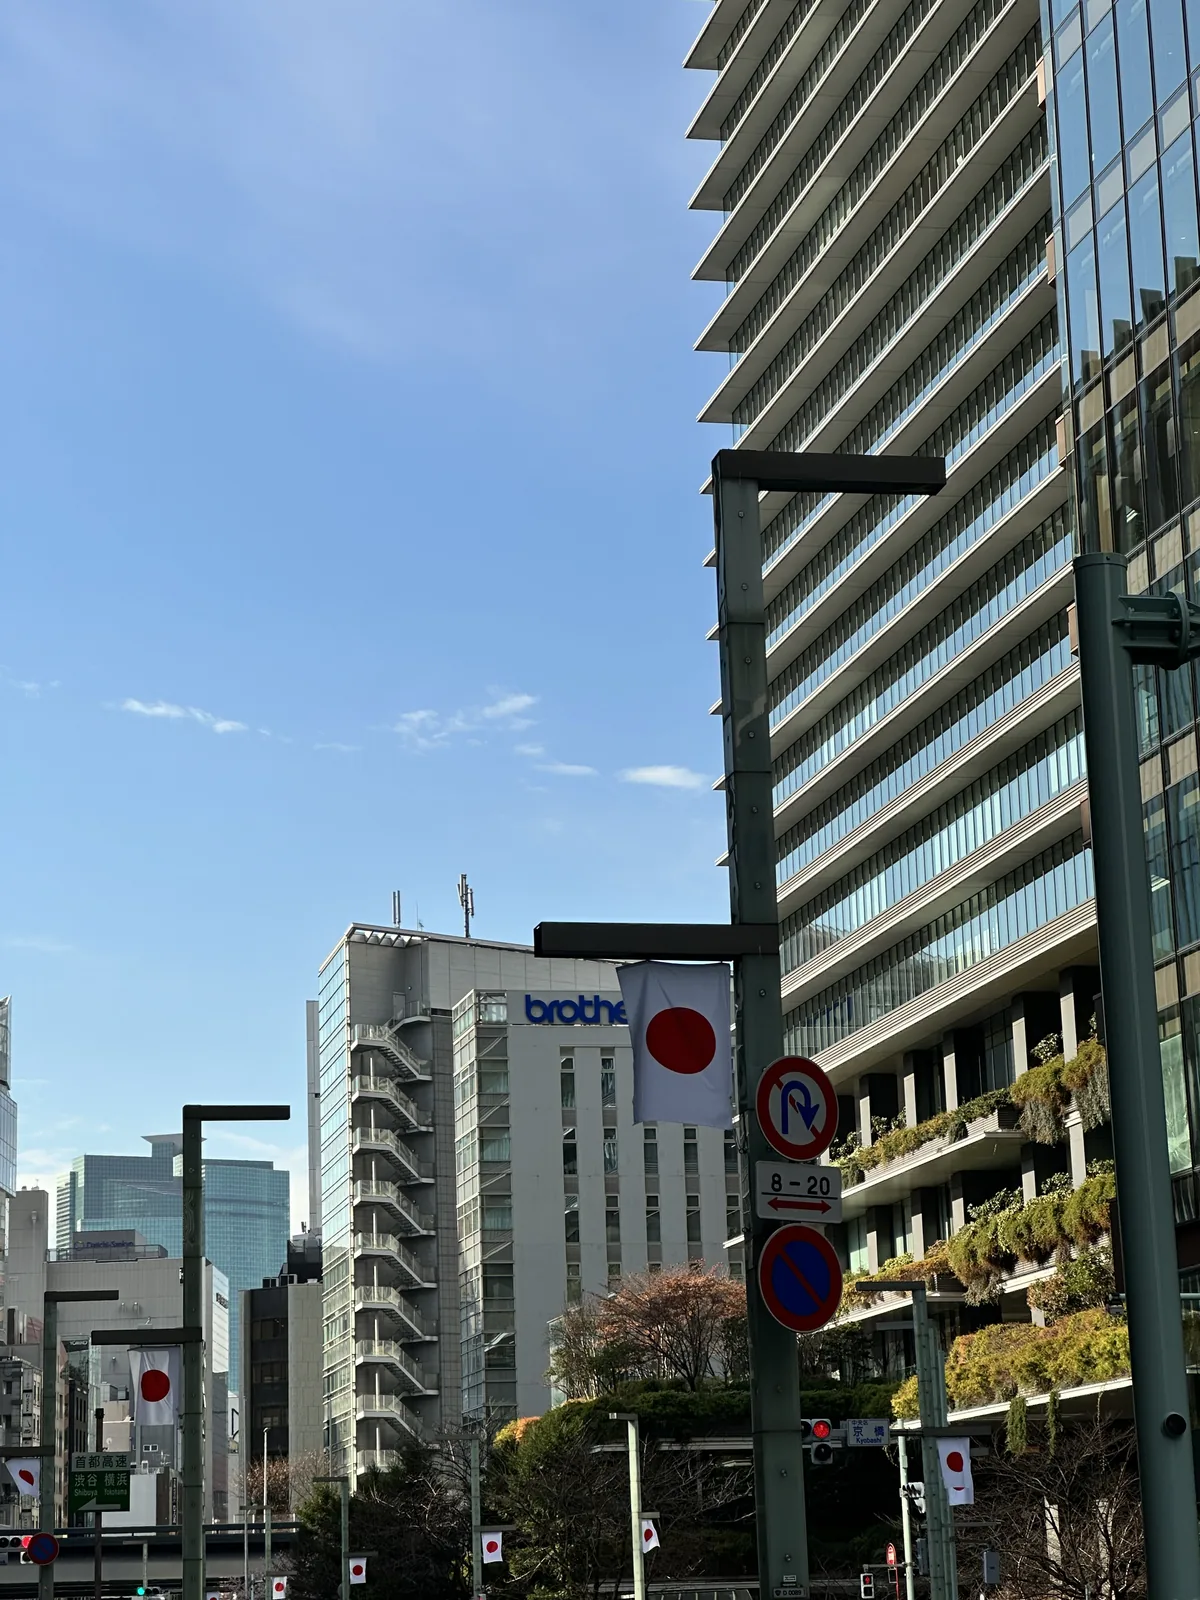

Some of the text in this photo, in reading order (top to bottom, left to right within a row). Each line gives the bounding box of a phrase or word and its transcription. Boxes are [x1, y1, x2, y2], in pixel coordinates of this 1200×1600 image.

[525, 994, 628, 1023] brothe
[75, 1454, 128, 1469] 首都高速
[74, 1472, 128, 1487] 渋谷 横浜
[74, 1488, 128, 1497] Shibuya Yokohama
